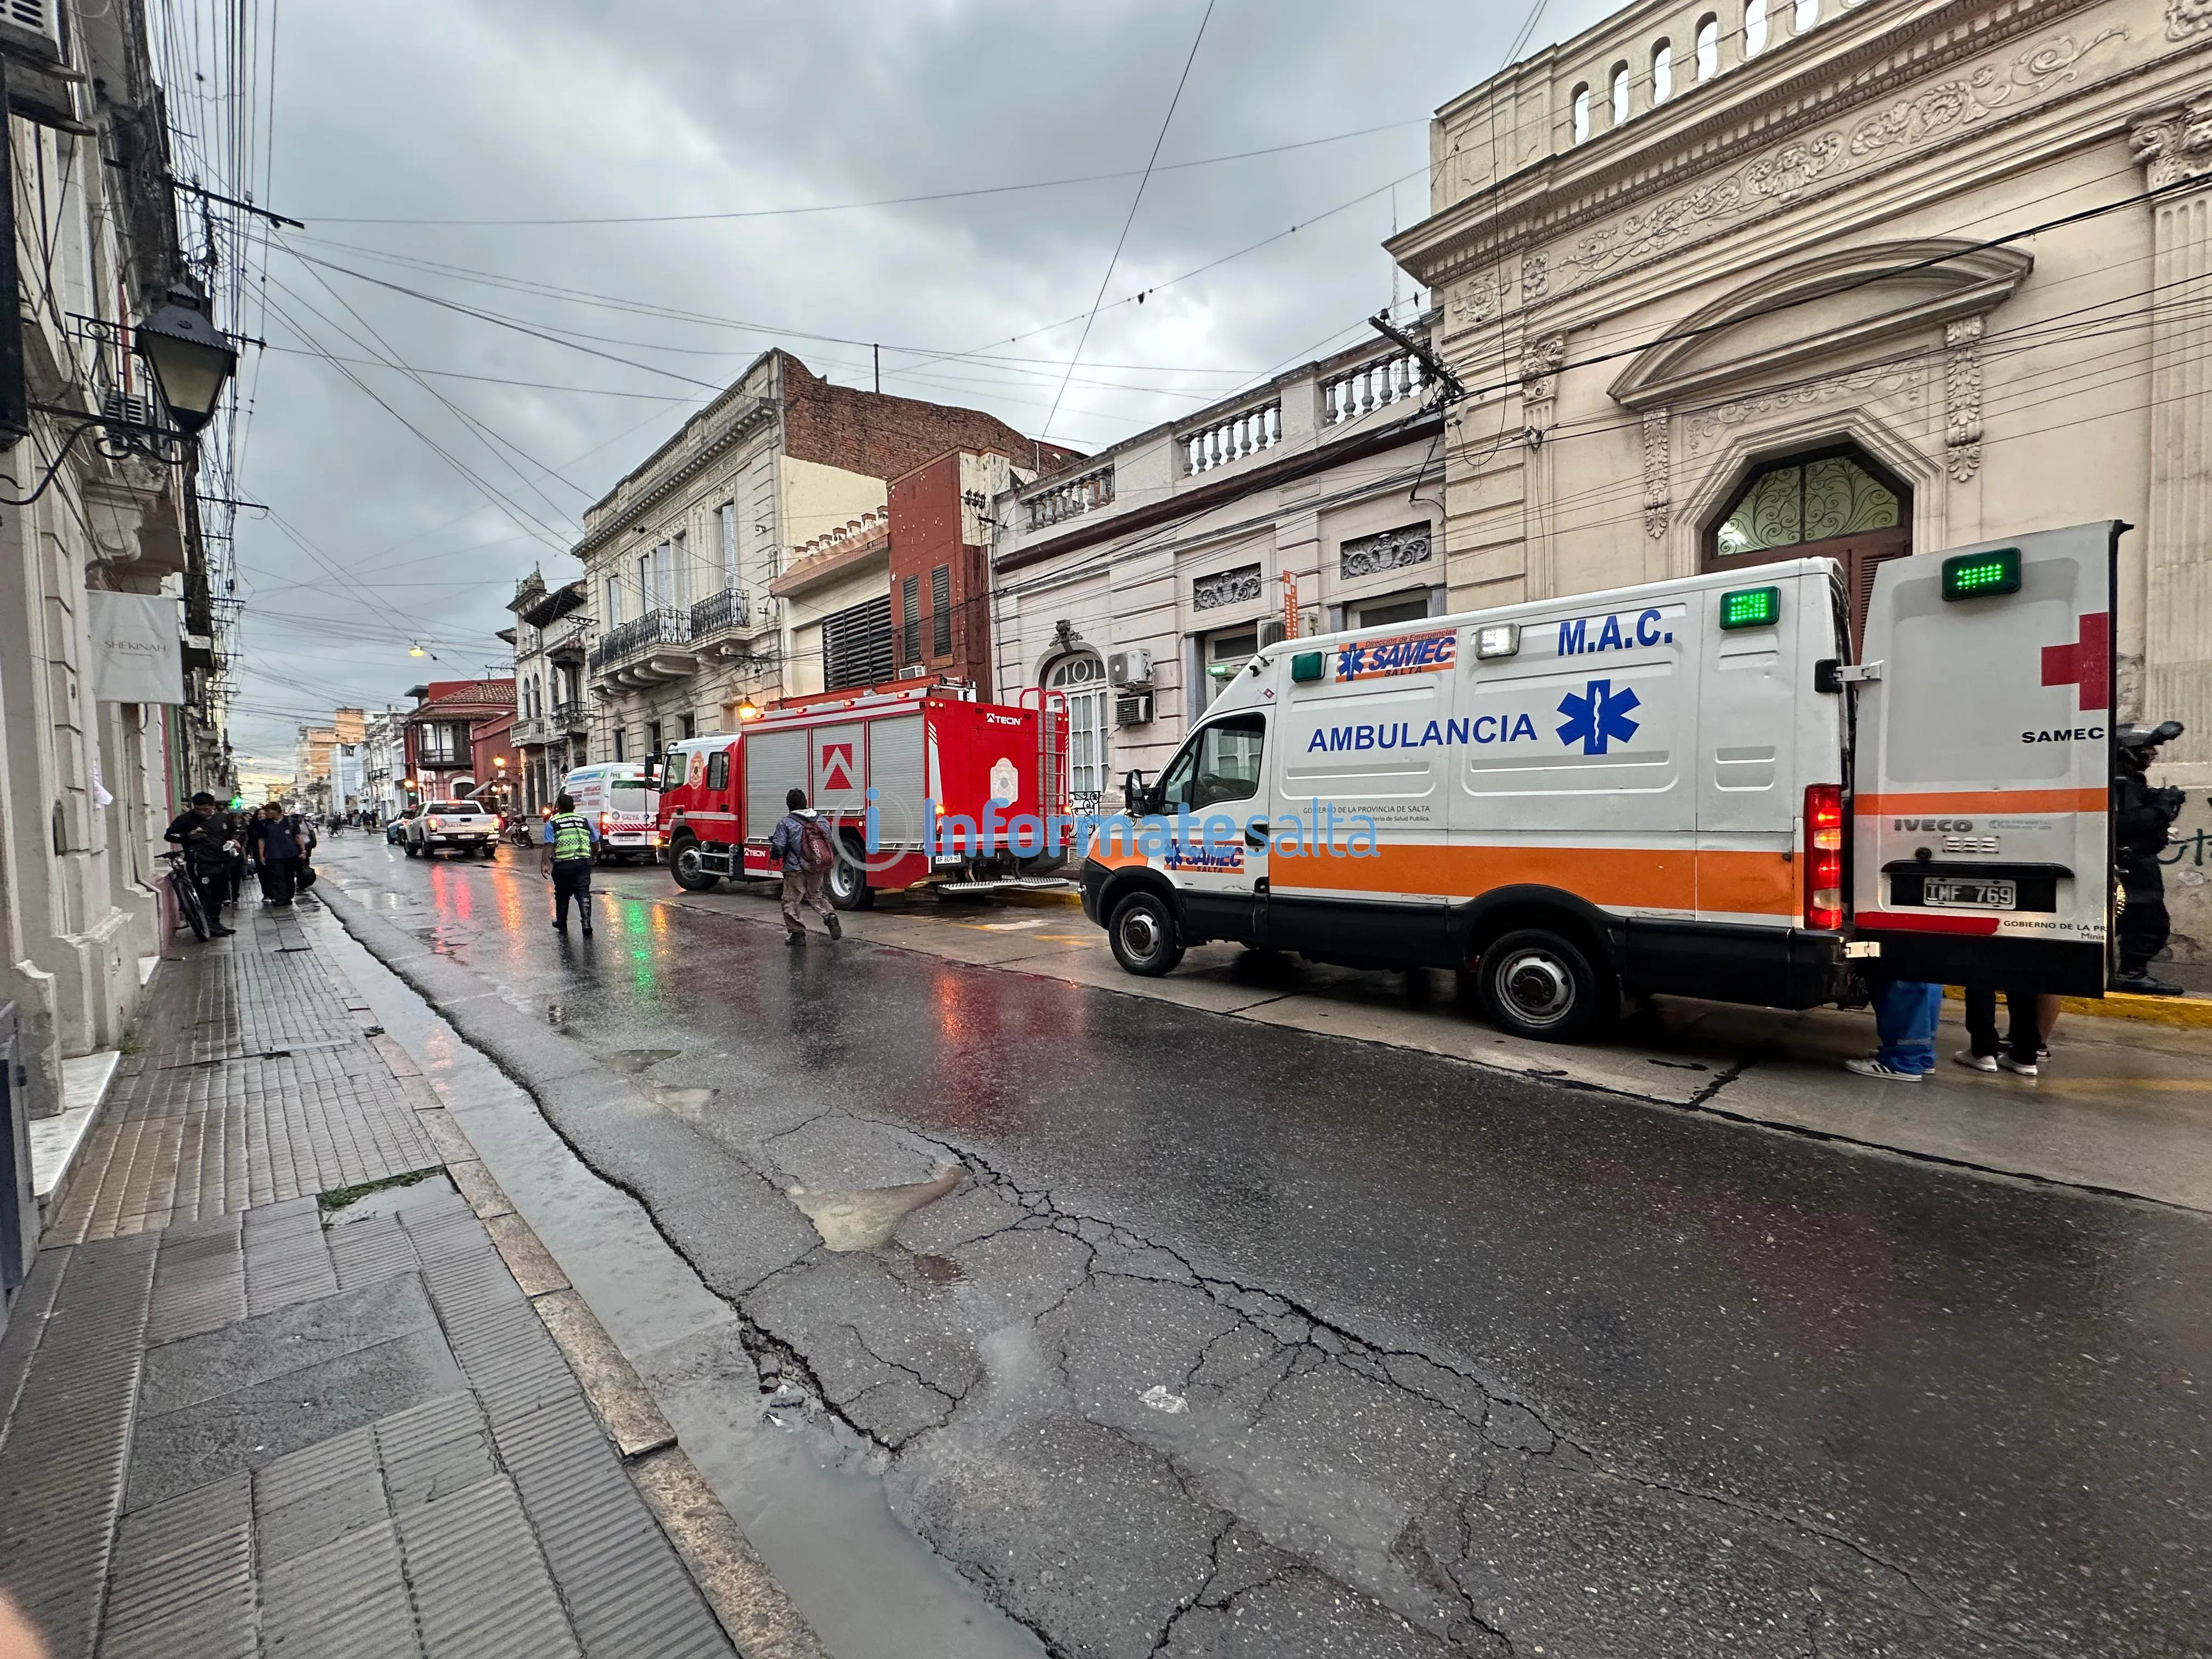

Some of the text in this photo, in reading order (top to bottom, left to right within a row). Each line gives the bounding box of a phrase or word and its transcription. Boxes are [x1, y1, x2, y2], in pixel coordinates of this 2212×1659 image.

[1398, 634, 1408, 642] de
[1409, 628, 1457, 642] Emergencias
[1558, 608, 1673, 657] M.A.C.
[104, 640, 167, 652] SHEKINAH
[1368, 636, 1456, 672] SAMEC
[1384, 665, 1423, 678] SALTA
[1307, 713, 1538, 753] AMBULANCIA
[2021, 727, 2104, 743] SAMEC
[1894, 819, 1973, 832] IVECO
[1186, 845, 1244, 867] SAMEC
[1975, 886, 2012, 904] 769
[2004, 921, 2056, 929] GOBIERNO
